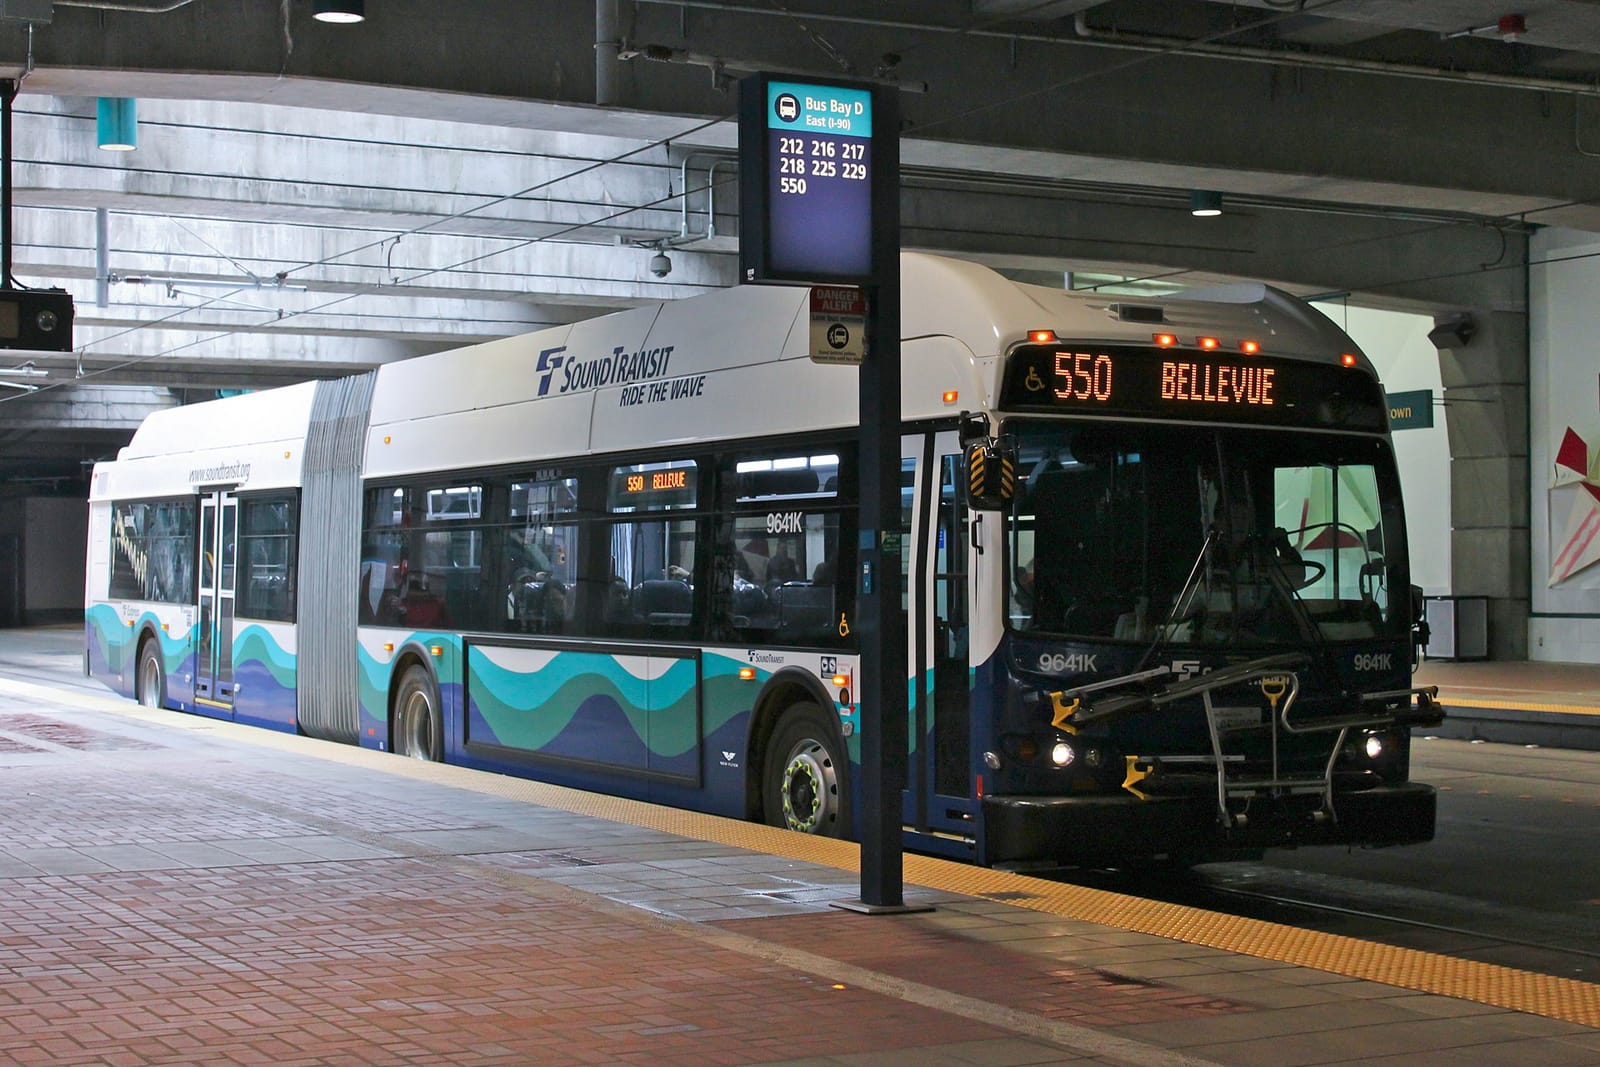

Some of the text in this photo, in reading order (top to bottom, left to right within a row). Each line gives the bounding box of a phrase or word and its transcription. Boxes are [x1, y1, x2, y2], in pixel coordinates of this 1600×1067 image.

[805, 96, 863, 117] Bus Bay D
[805, 114, 851, 131] East (I-90)
[780, 138, 865, 160] 212 216 217
[780, 157, 867, 180] 218 225 229
[780, 177, 807, 194] 550
[816, 288, 858, 302] DANGER
[822, 300, 854, 311] ALERT
[1054, 352, 1275, 405] 550 BELLEVUE
[619, 375, 706, 407] RIDE THE WAVE
[1389, 407, 1412, 419] own
[188, 460, 251, 484] www.soundtransit.org
[627, 471, 686, 492] 550 BELLEVUE
[766, 511, 802, 534] 9641K
[1039, 653, 1098, 674] 9641K
[1353, 653, 1392, 672] 9641K
